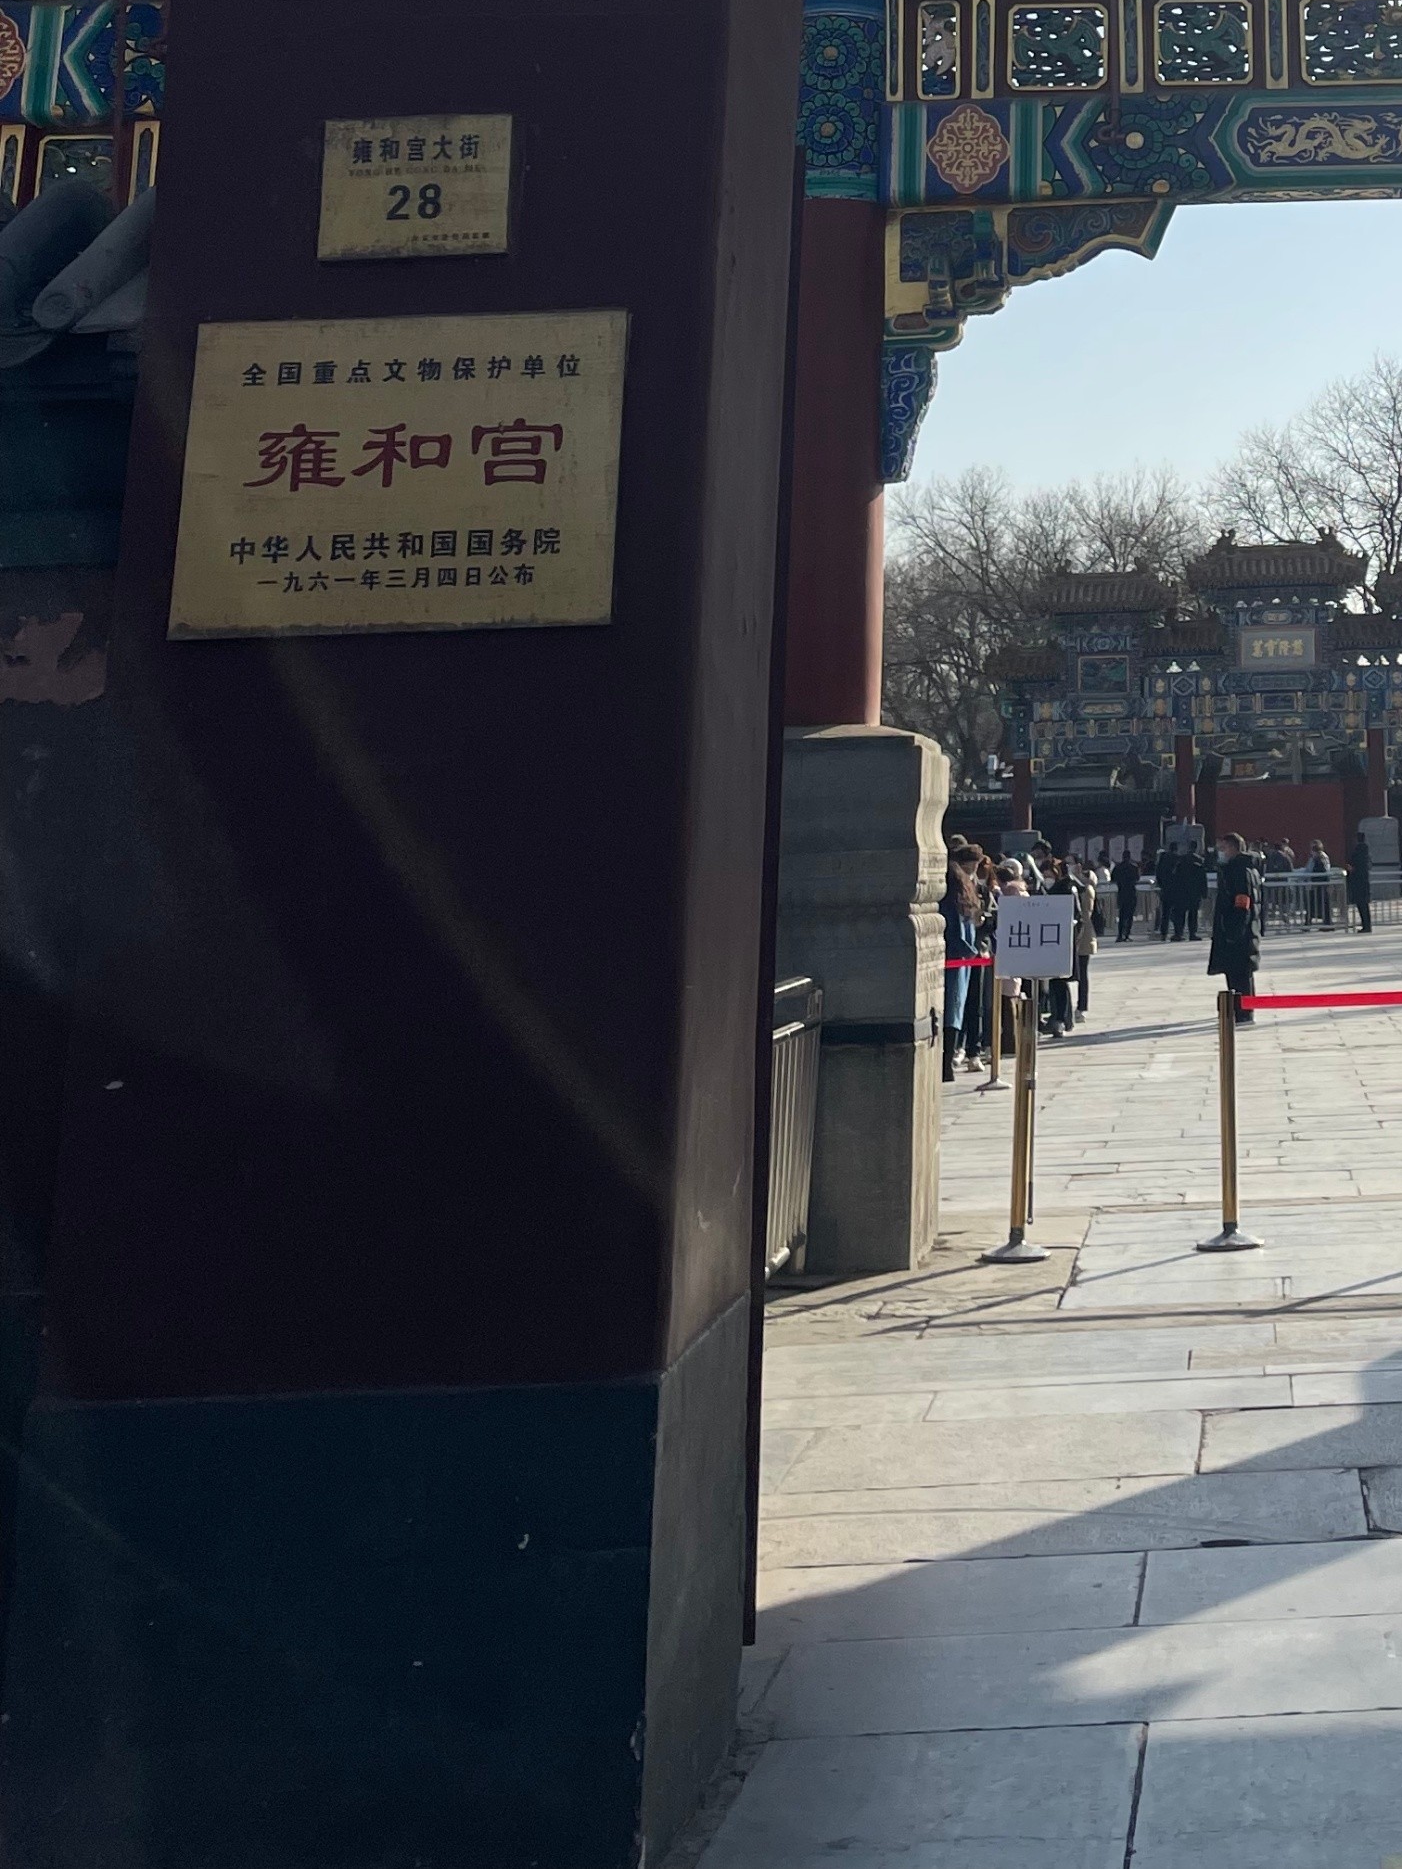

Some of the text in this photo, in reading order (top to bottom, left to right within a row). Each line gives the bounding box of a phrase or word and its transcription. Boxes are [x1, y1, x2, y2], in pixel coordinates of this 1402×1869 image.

[353, 134, 480, 164] 雍和宫大街
[386, 183, 442, 221] 28
[242, 354, 583, 387] 全国重点文物保护单位
[243, 418, 563, 492] 雍和宫
[229, 528, 561, 565] 中华人民共和国国务院
[257, 564, 535, 593] 一九六一年三月四日公布
[1008, 921, 1060, 948] 出口
